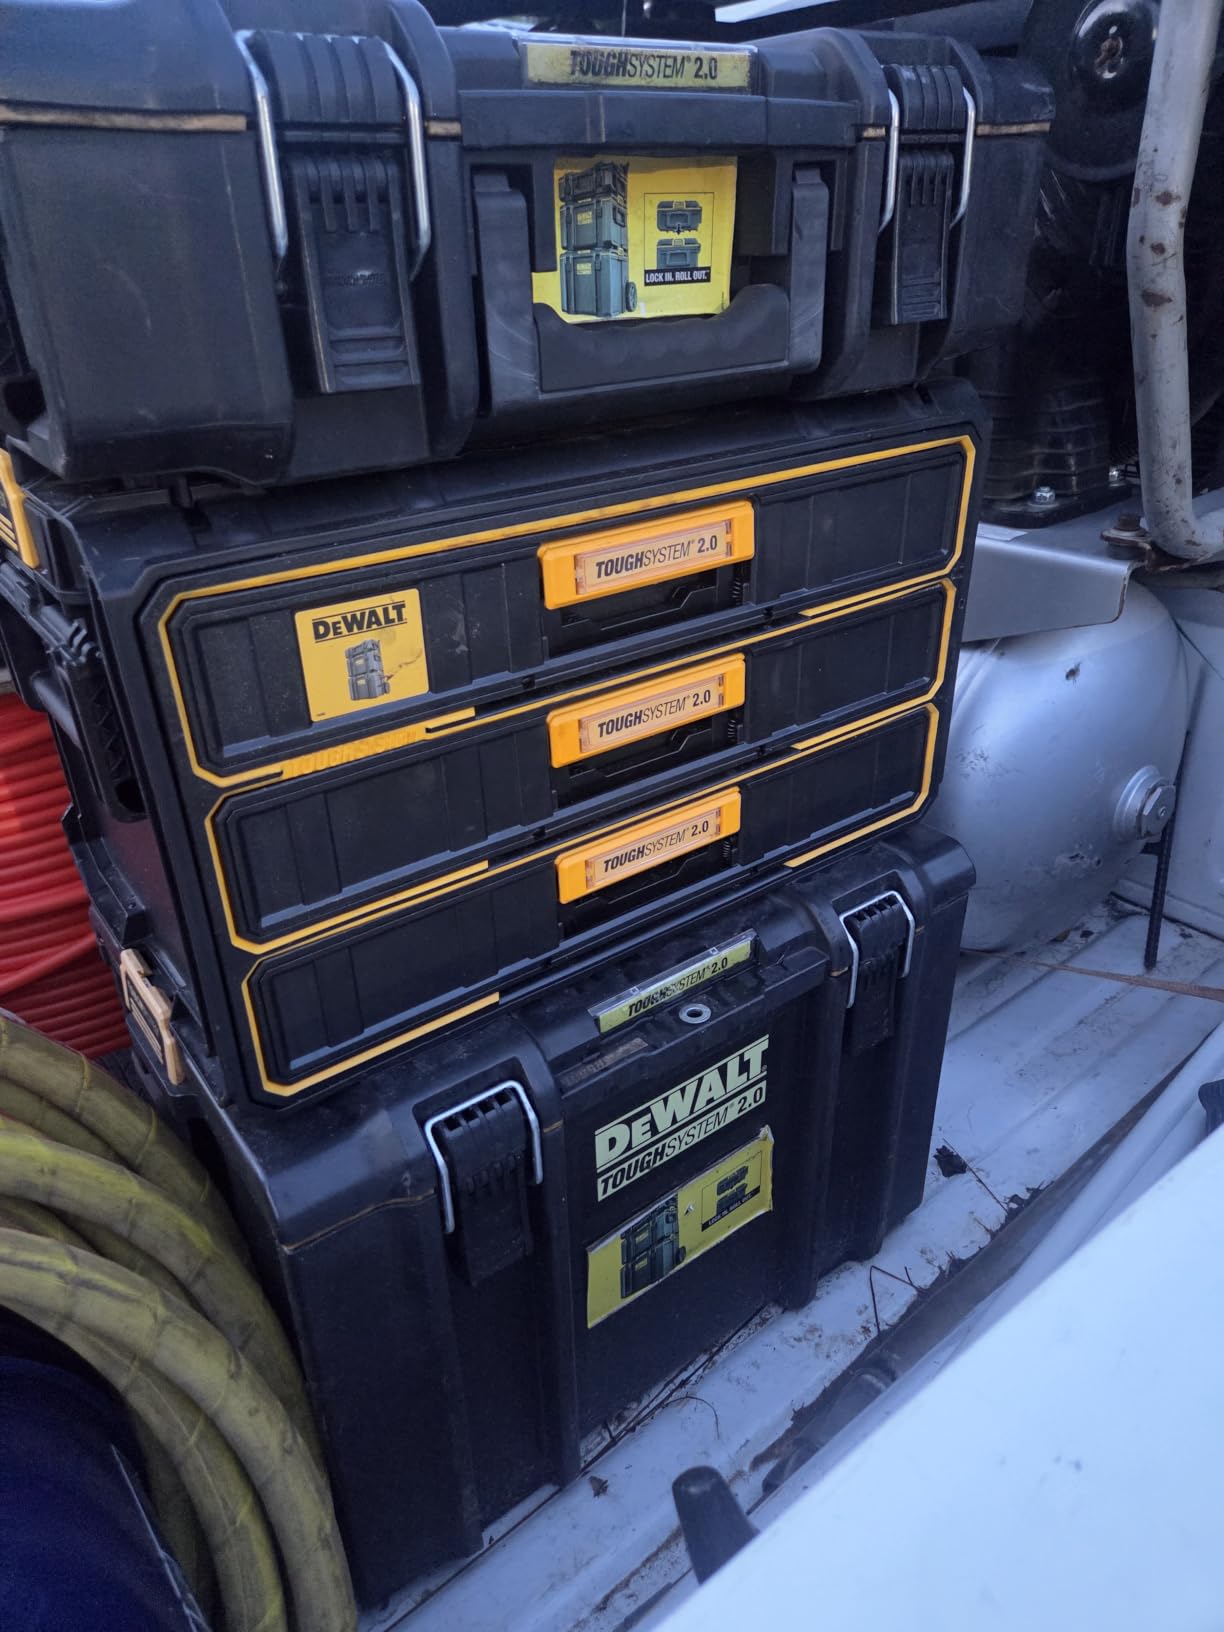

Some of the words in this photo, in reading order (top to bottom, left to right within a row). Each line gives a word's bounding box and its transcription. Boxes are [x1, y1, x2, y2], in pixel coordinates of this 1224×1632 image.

[694, 56, 718, 80] 2.0
[645, 272, 664, 283] LOCK
[675, 270, 692, 281] ROLL
[697, 535, 718, 554] 2.0
[692, 689, 711, 707] 2.0
[691, 820, 709, 837] 2.0
[711, 957, 728, 974] 2.0
[737, 1086, 763, 1116] 2.0
